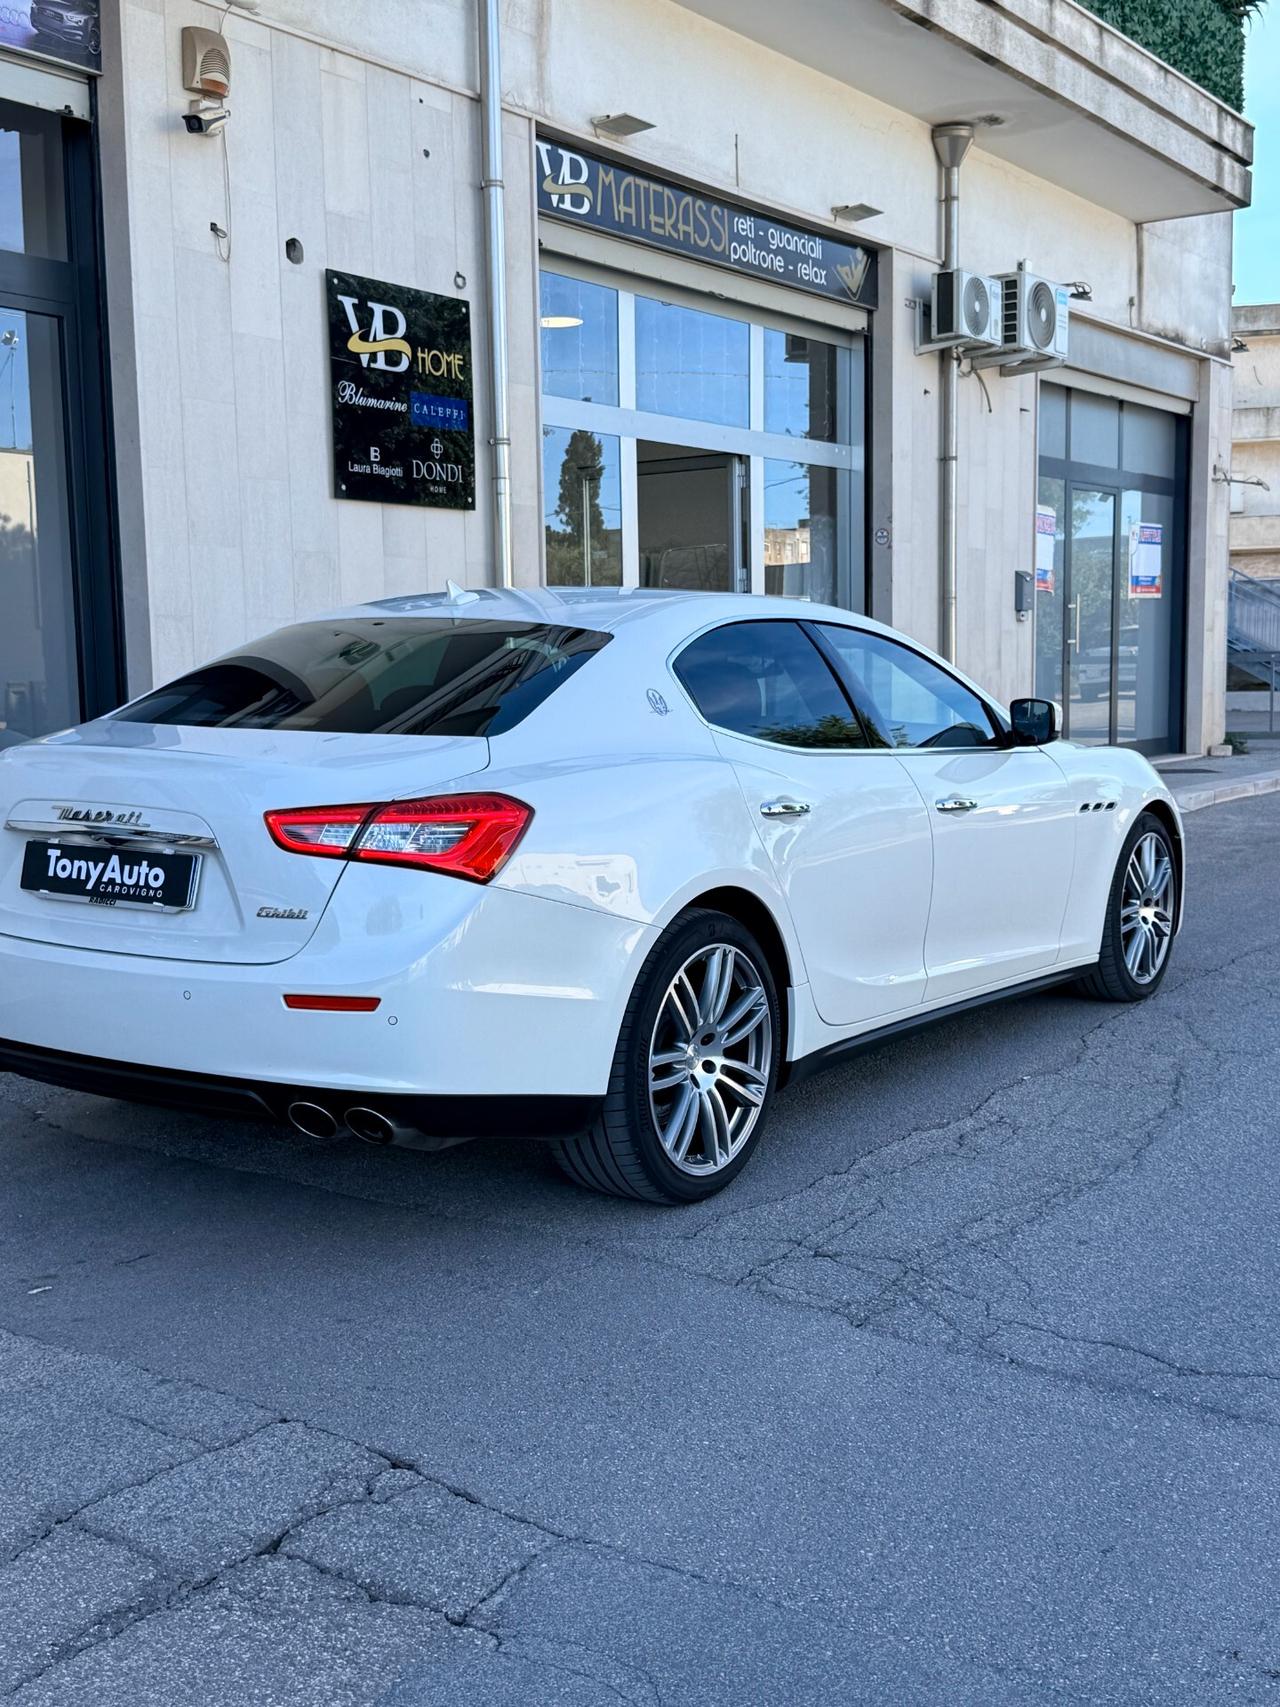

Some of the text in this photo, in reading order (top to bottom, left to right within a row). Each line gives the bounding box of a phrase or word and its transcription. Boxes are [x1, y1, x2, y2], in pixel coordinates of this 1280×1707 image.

[597, 166, 729, 256] MATERASSI
[734, 215, 755, 238] reti
[768, 227, 823, 261] guanciali
[730, 242, 785, 273] poltrone
[797, 260, 827, 286] relax
[417, 346, 465, 381] HOME
[338, 381, 408, 413] Blumarine
[413, 402, 465, 420] CALEFFI
[348, 461, 404, 479] Laura Biagiotti
[412, 460, 464, 483] DONDI
[430, 486, 447, 494] HOME
[47, 848, 166, 890] TonyAuto
[99, 883, 164, 898] CAROVIGNO
[256, 906, 309, 920] Ghibli
